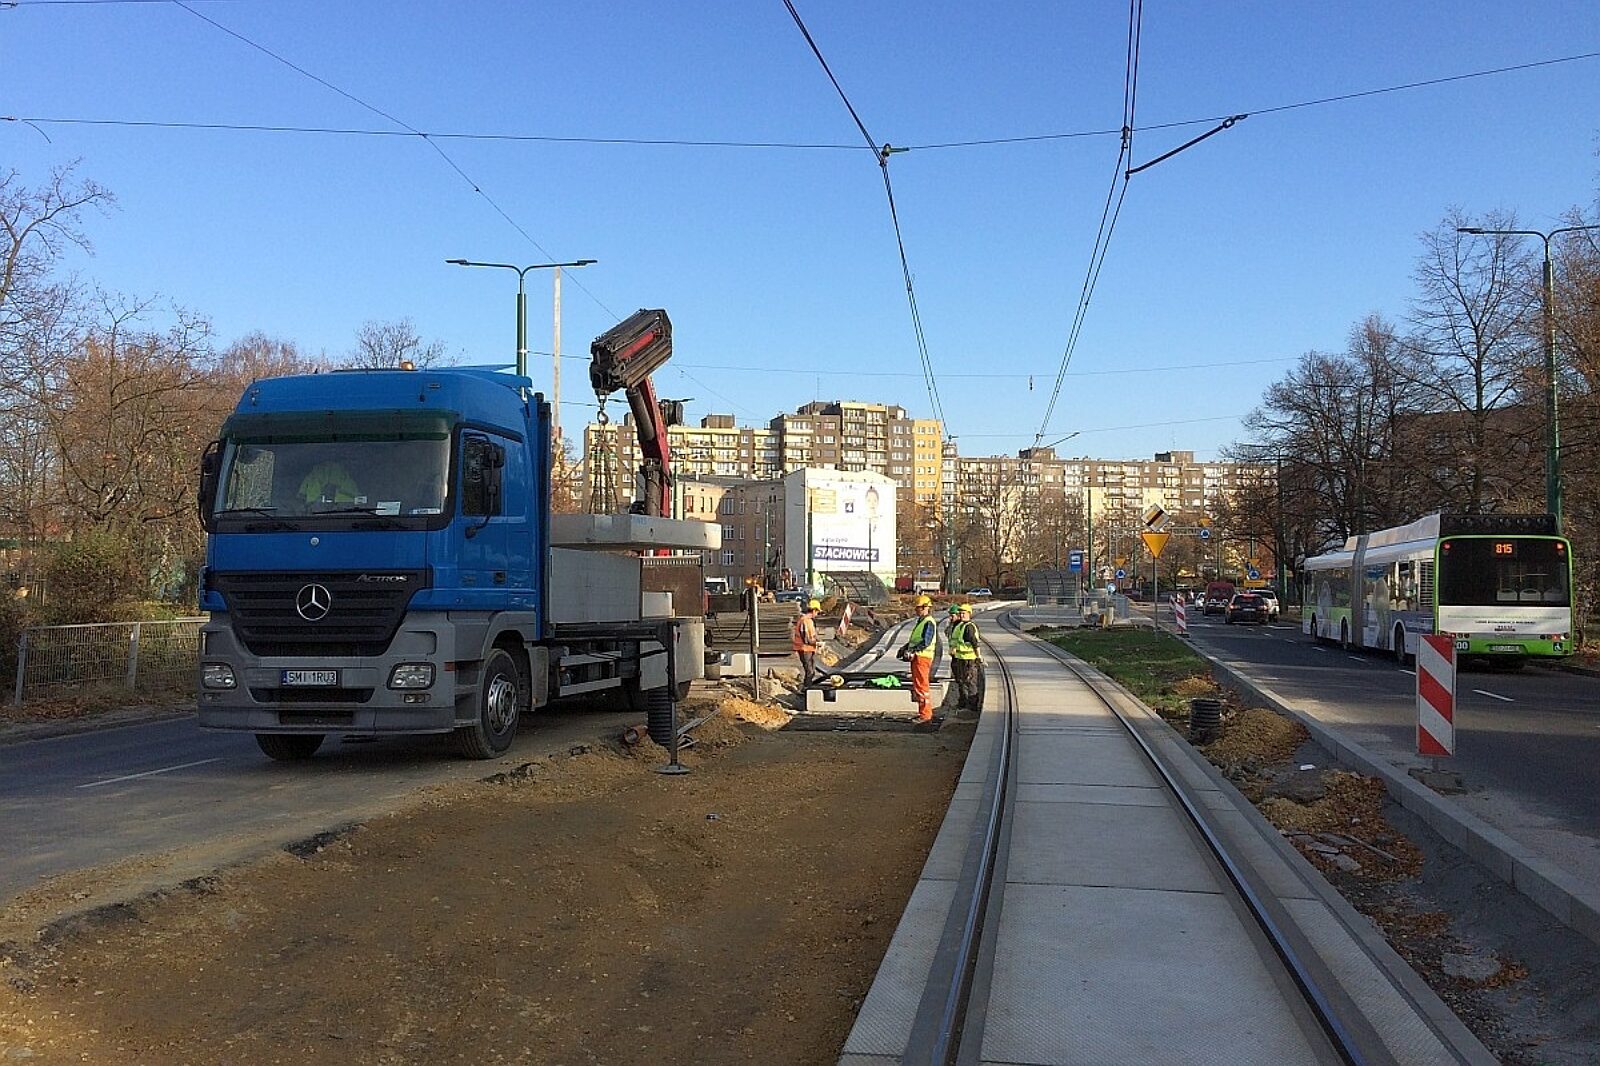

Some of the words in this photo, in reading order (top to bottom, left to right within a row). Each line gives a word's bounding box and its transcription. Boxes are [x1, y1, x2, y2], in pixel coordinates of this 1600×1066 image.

[814, 547, 877, 560] STACHOWICZ
[1495, 544, 1513, 553] 815
[288, 672, 306, 683] SMI
[312, 672, 336, 683] 1RU3
